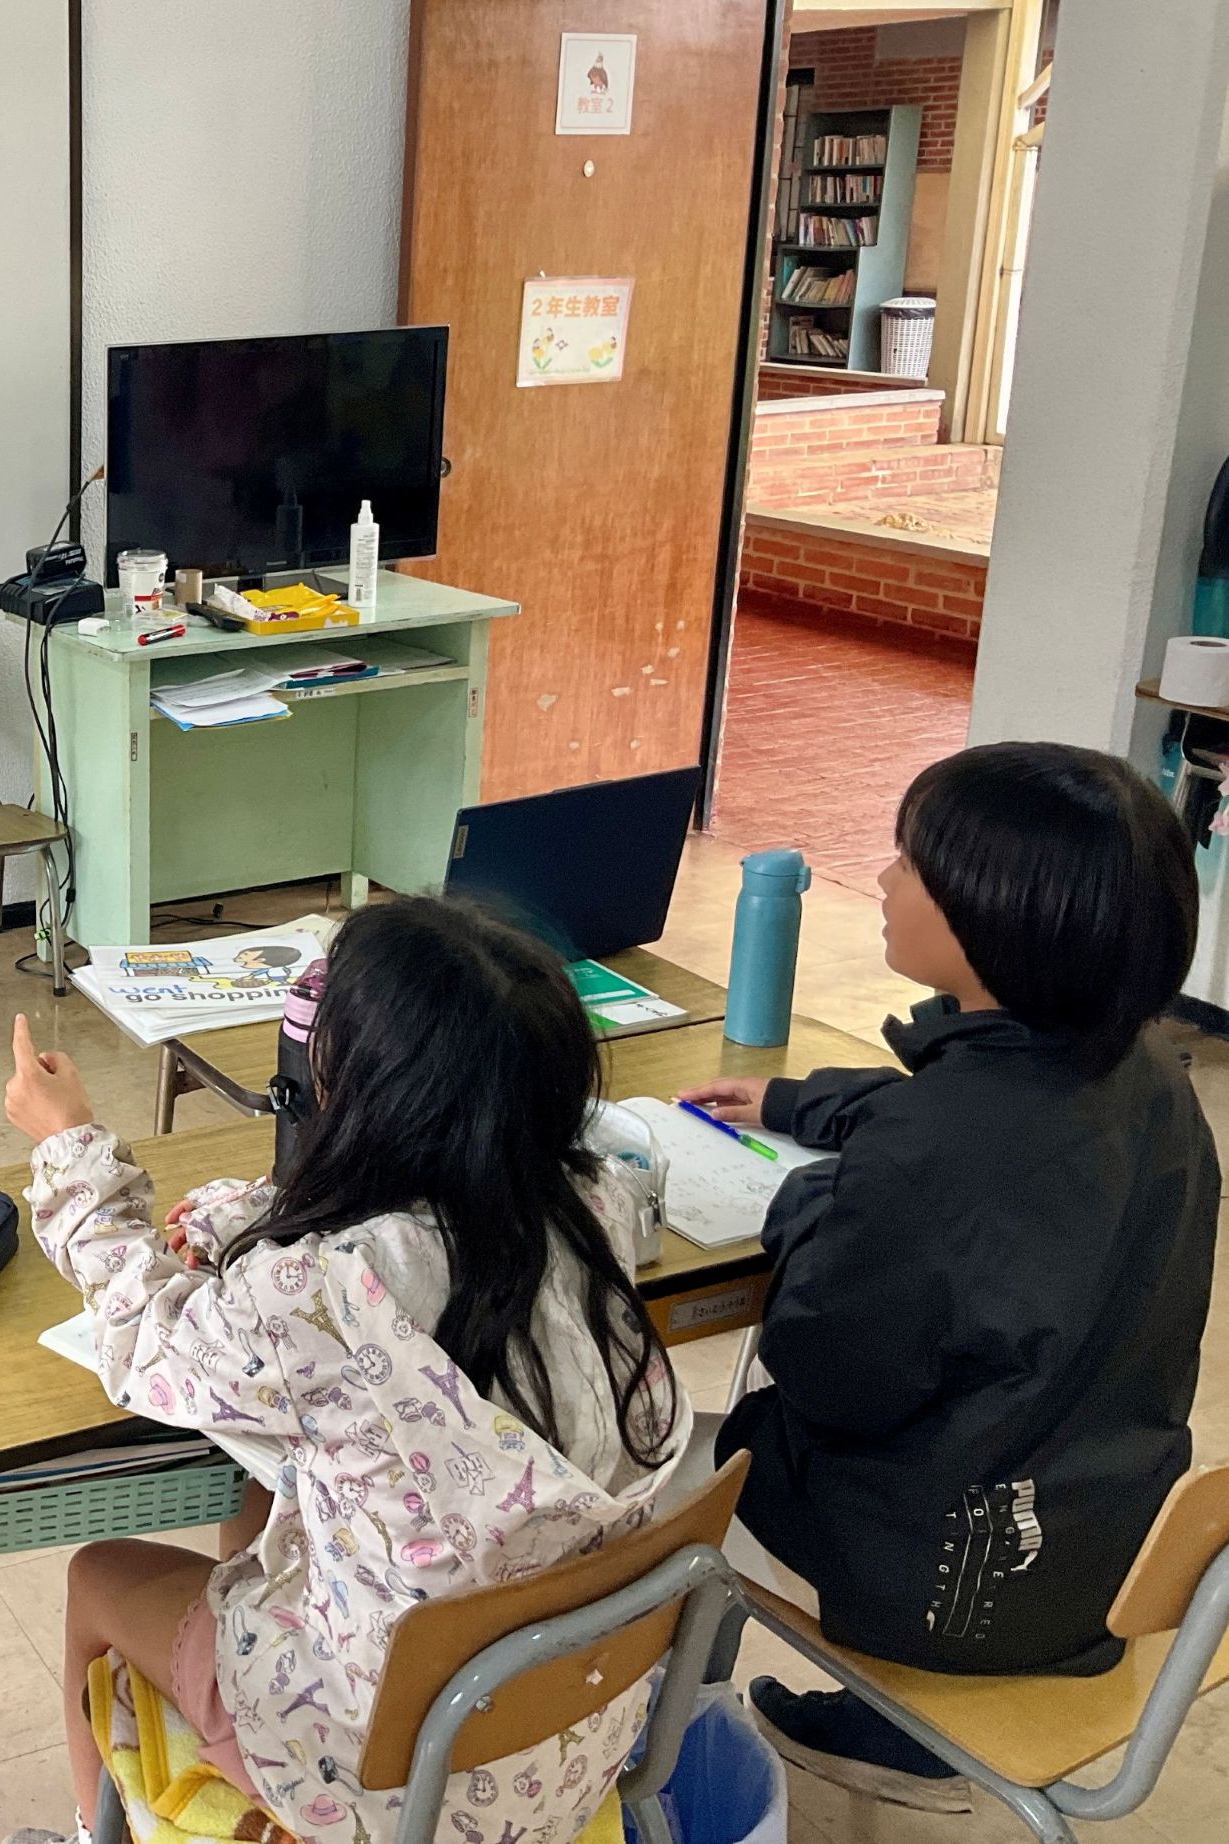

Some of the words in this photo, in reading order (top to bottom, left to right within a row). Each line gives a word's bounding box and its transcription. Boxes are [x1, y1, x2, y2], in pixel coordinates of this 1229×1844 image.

[530, 295, 620, 318] 2年生教室
[108, 984, 187, 994] went
[125, 994, 161, 1003] go
[172, 988, 291, 1002] shoppin
